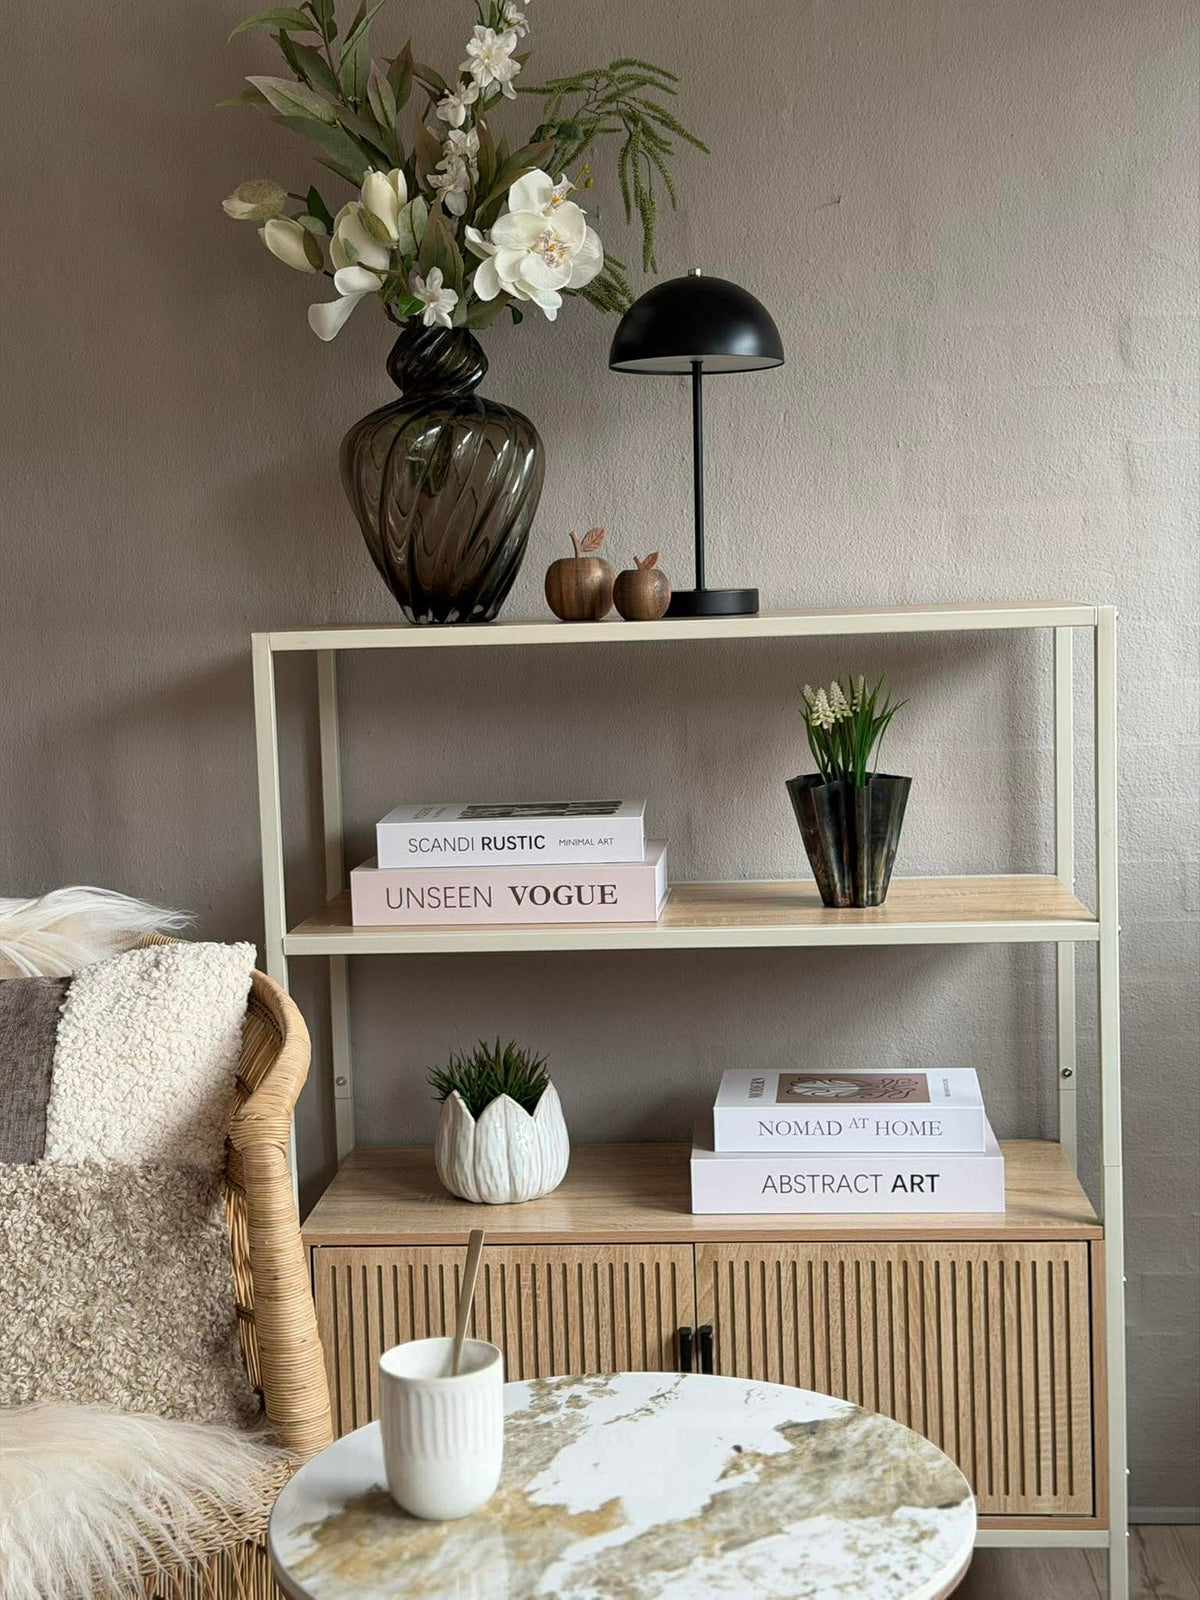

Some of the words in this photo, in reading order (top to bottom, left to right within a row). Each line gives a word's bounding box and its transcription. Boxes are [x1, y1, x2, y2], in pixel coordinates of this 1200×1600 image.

[408, 836, 475, 853] SCANDI
[481, 834, 546, 851] RUSTIC
[558, 838, 595, 847] MINIMAL
[597, 837, 615, 846] ART
[386, 886, 492, 909] UNSEEN
[508, 884, 618, 906] VOGUE
[758, 1120, 842, 1136] NOMAD
[849, 1117, 869, 1129] AT
[876, 1120, 943, 1136] HOME
[761, 1174, 883, 1193] ABSTRACT
[891, 1174, 940, 1193] ART
